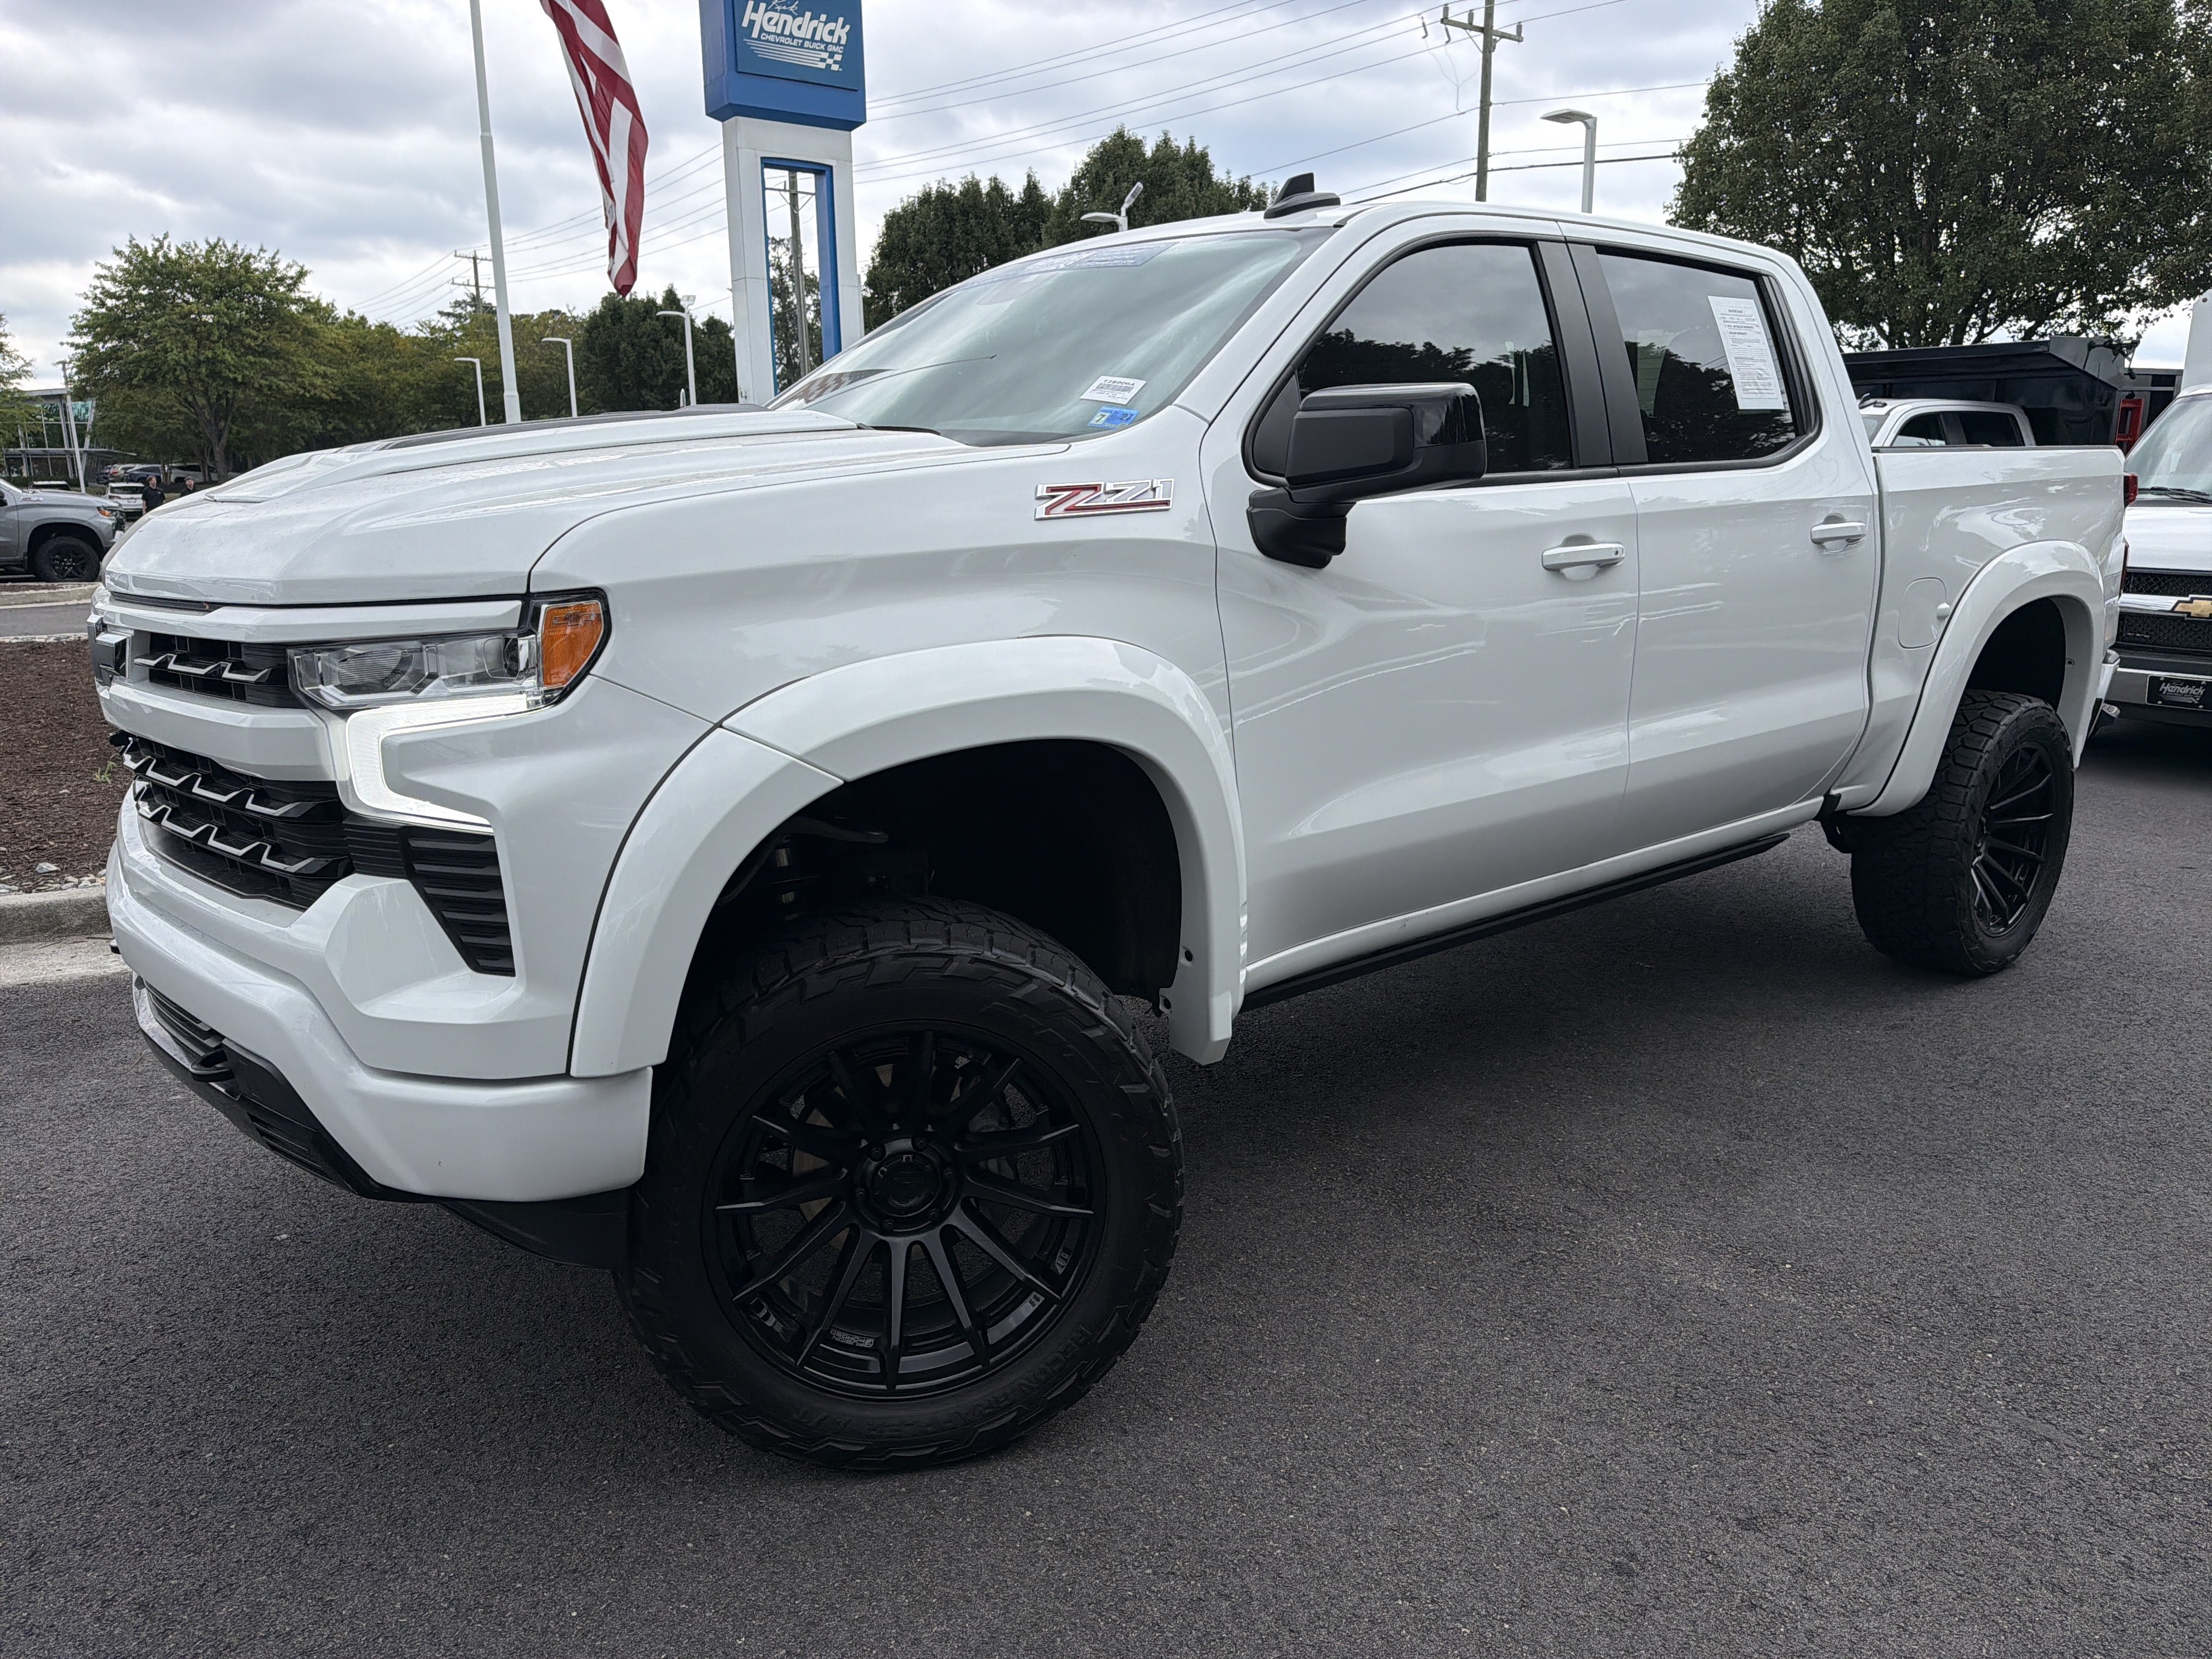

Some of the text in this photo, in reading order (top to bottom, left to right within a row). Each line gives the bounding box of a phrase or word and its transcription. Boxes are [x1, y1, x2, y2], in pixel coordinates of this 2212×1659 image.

[742, 1, 850, 45] Hendrick
[760, 33, 844, 53] CHEVROLET BUICK GMC
[1096, 413, 1134, 422] 7 27
[1035, 478, 1174, 521] Z71
[2159, 682, 2205, 696] Hendrick
